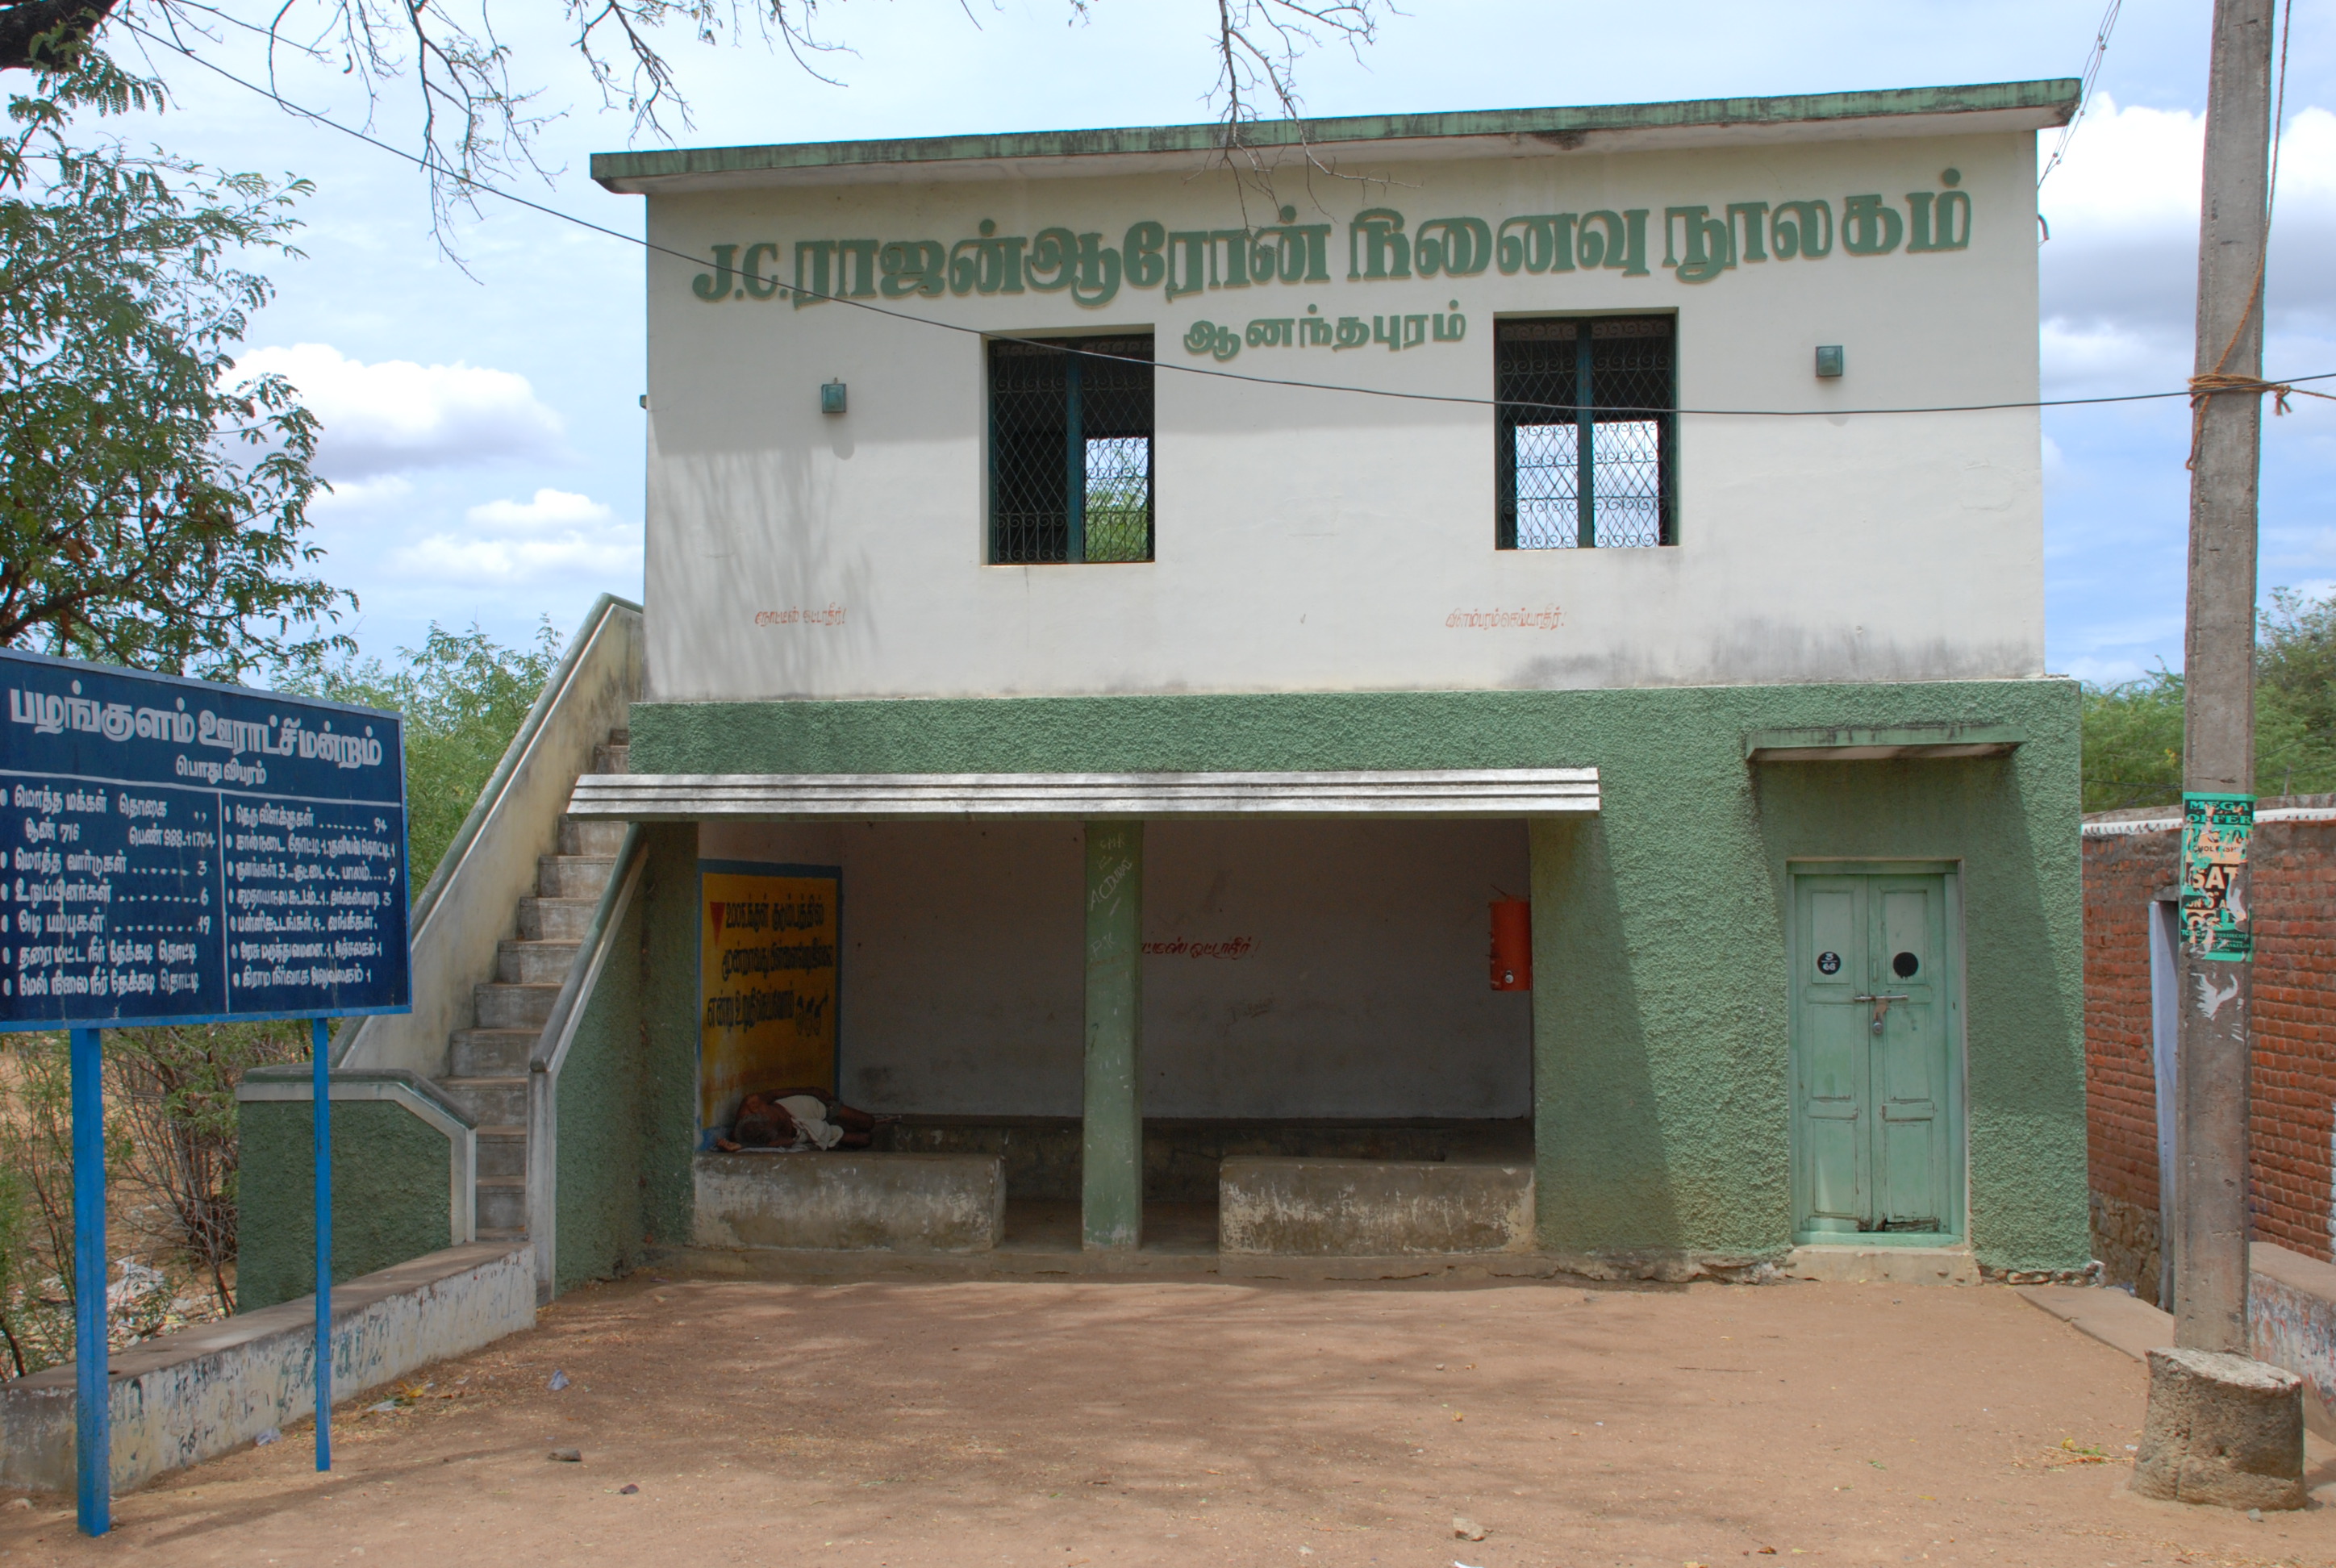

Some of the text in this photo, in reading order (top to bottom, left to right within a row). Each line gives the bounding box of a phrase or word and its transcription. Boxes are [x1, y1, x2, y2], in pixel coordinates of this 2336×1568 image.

[1346, 205, 1650, 282] நினைவு
[1662, 167, 1972, 284] நூலகம்
[1183, 298, 1467, 361] ஆனந்தபுரம்
[9, 679, 195, 743] பழங்குளம்
[299, 720, 383, 769] மன்றம்
[176, 754, 268, 786] பொது விபரம்
[14, 784, 168, 819] மொத்த மக்கள் தொகை
[2188, 799, 2250, 811] MEGA
[25, 816, 56, 844] ஆண்
[60, 823, 81, 844] 716
[128, 822, 163, 848] பெண்
[373, 816, 389, 835] 94
[2186, 812, 2254, 824] OFFER
[14, 845, 207, 878] மொத்த வார்டுகள் 3
[15, 877, 209, 909] உறுப்பினர்கள் 6
[18, 908, 43, 939] அடி
[46, 906, 106, 939] பம்புகள்
[51, 968, 89, 995] நிலை
